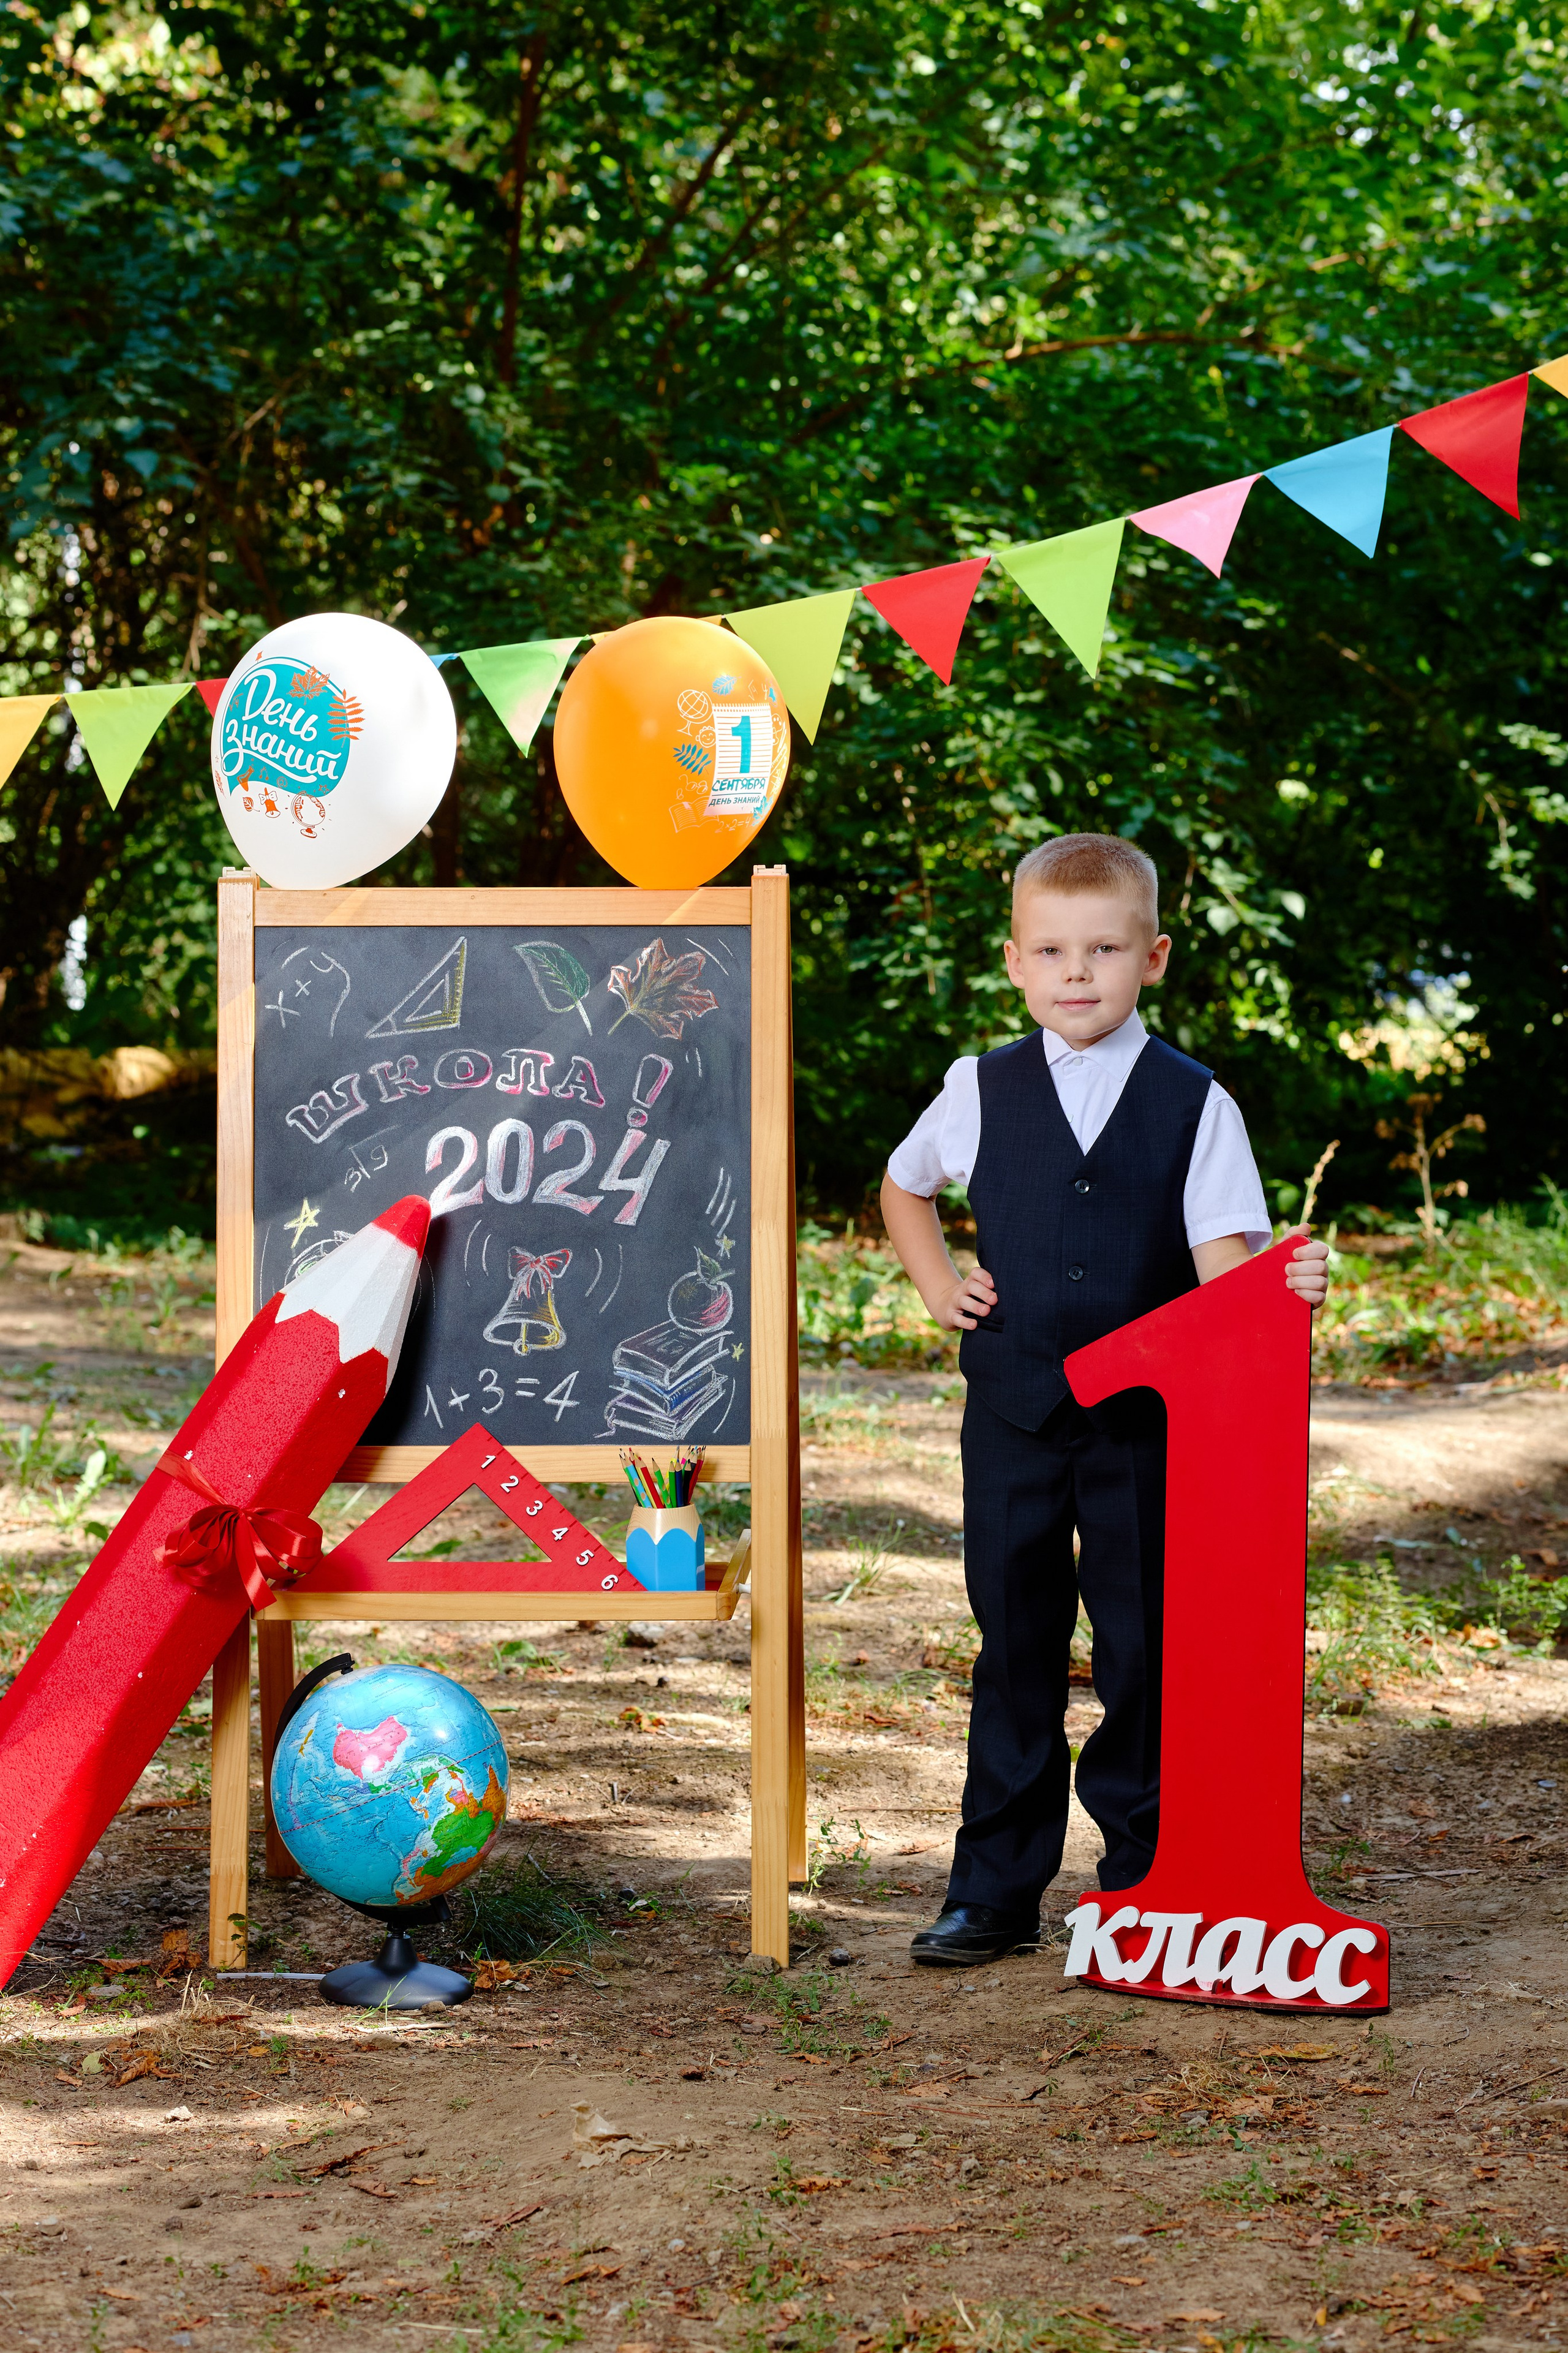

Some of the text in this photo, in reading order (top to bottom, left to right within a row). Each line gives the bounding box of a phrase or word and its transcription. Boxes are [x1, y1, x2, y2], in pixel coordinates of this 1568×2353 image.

[243, 668, 318, 741] День
[731, 716, 751, 773] 1
[708, 796, 760, 807] ДЕНЬ ЗНАНИЙ
[712, 777, 766, 791] СЕНТЯБРЯ
[424, 1118, 671, 1226] 2024
[480, 1454, 619, 1590] 1 2 3 4 5 6
[1063, 1235, 1390, 2016] 1
[1064, 1902, 1378, 2005] класс
